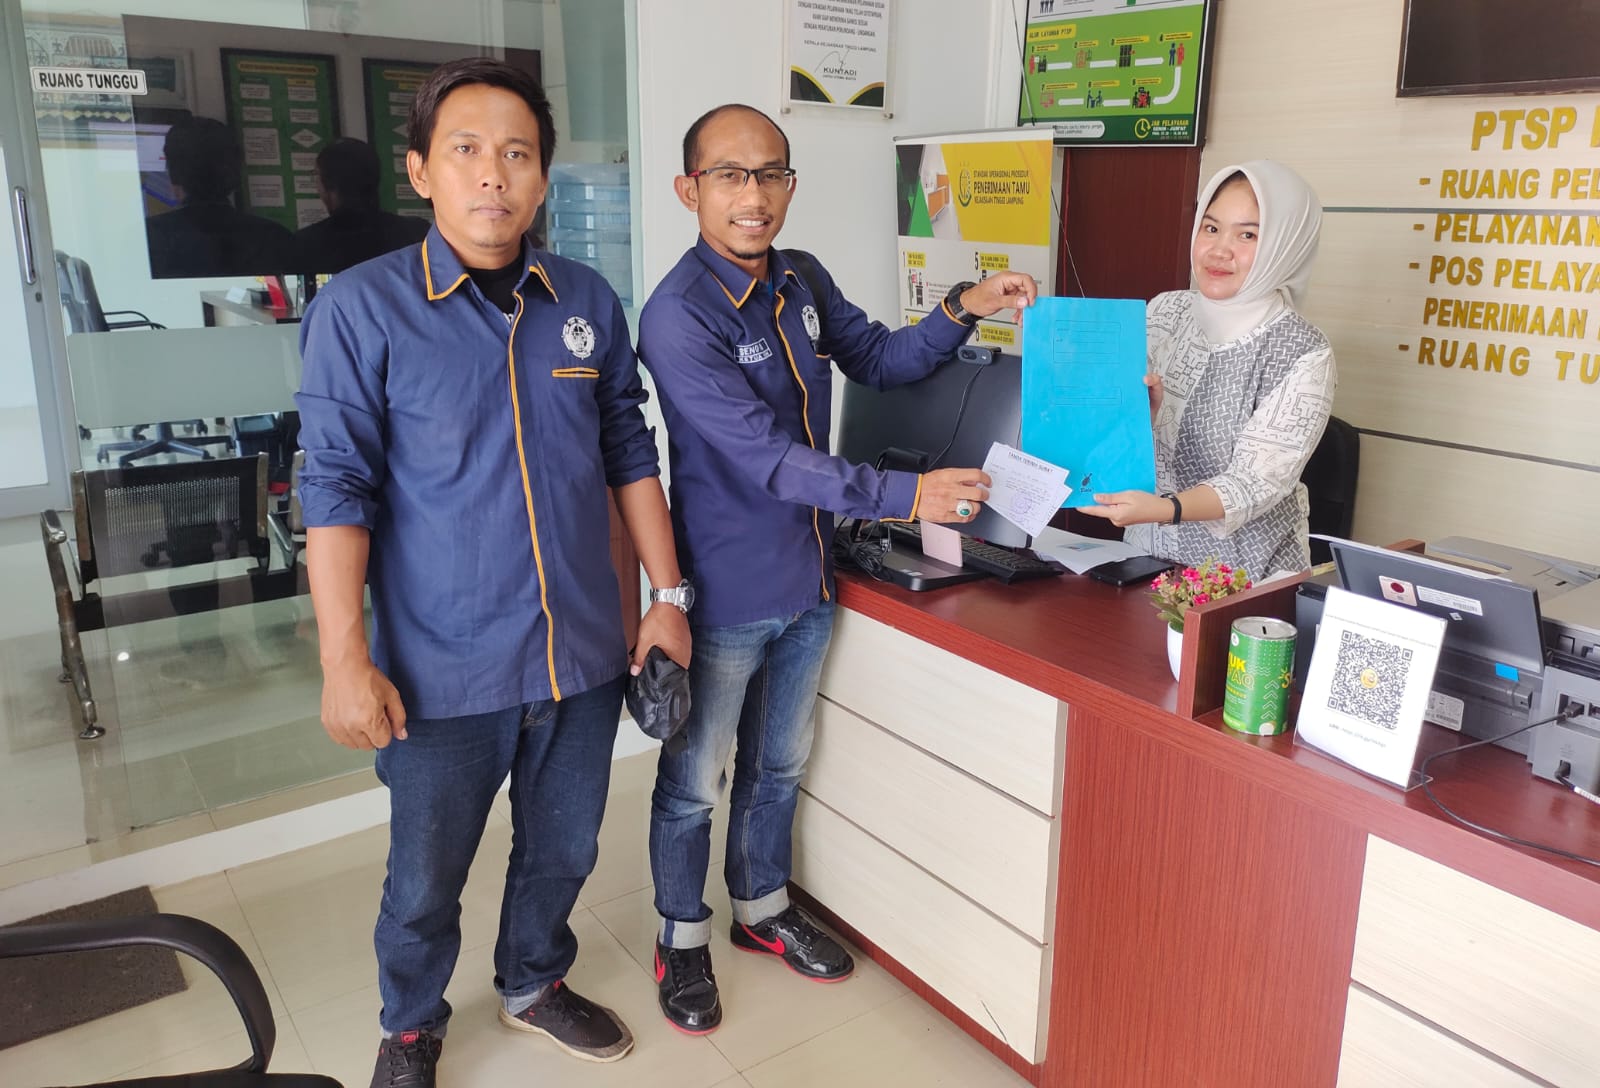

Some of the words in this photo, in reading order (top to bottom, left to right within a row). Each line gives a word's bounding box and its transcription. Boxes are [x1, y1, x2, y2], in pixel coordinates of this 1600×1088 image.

[40, 72, 83, 88] RUANG
[86, 74, 138, 89] TUNGGU
[823, 66, 857, 76] KUNTADI
[1471, 106, 1578, 152] PTSP
[974, 181, 1010, 194] PENERIMAAN
[1012, 182, 1030, 194] TAMU
[1440, 168, 1540, 200] RUANG
[1429, 255, 1483, 286] POS
[1424, 298, 1588, 339] PENERIMAAN
[1418, 337, 1530, 376] RUANG
